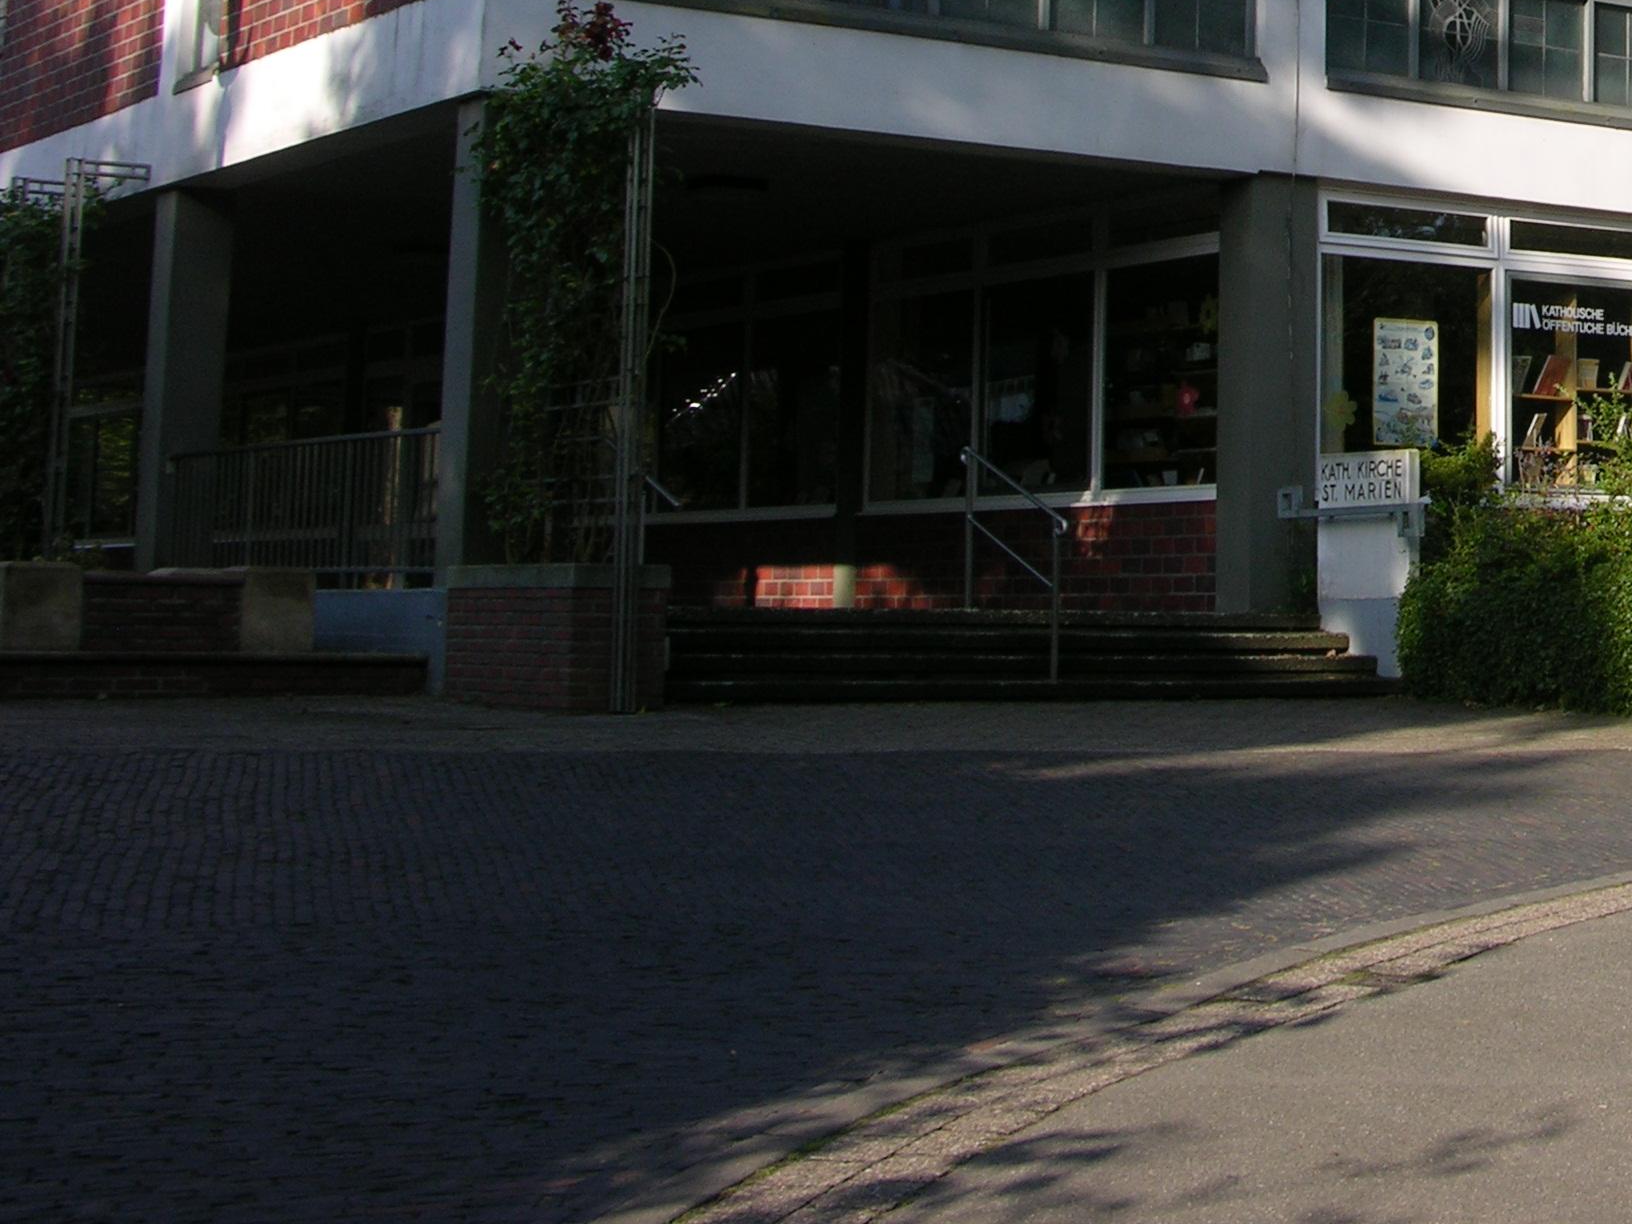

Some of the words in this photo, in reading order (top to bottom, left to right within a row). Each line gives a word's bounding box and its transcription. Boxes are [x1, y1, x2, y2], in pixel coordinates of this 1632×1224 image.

[1541, 305, 1604, 321] KATHOLISCHE
[1541, 317, 1605, 335] ÖFFENTLICHE
[1321, 462, 1351, 481] KATH.
[1357, 459, 1402, 479] KIRCHE
[1322, 484, 1338, 502] ST.
[1344, 480, 1402, 501] MARIEN
